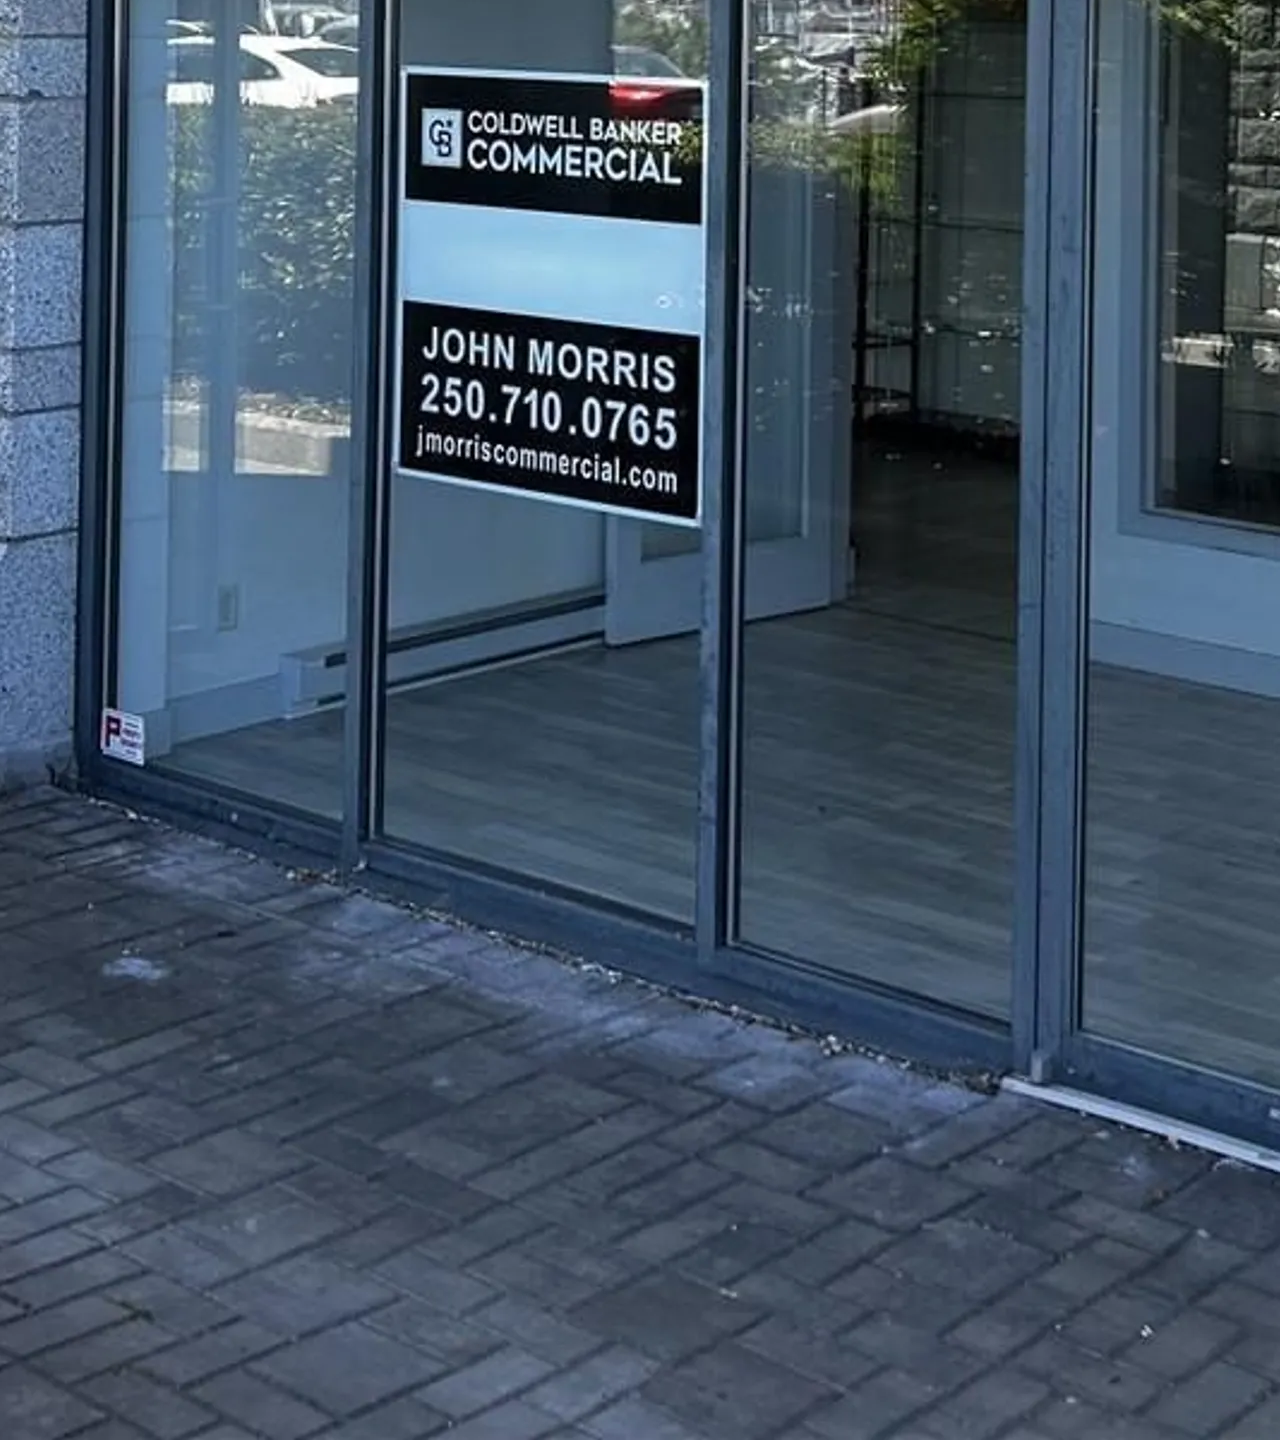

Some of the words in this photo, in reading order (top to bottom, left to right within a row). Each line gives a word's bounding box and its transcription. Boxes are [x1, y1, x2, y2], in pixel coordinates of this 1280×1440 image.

[467, 110, 583, 139] COLDWELL
[590, 118, 682, 146] BANKER
[467, 139, 682, 185] COMMERCIAL
[422, 326, 515, 371] JOHN
[528, 339, 676, 393] MORRIS
[421, 373, 677, 451] 250.710.0765
[416, 425, 678, 494] jmorriscommercial.com
